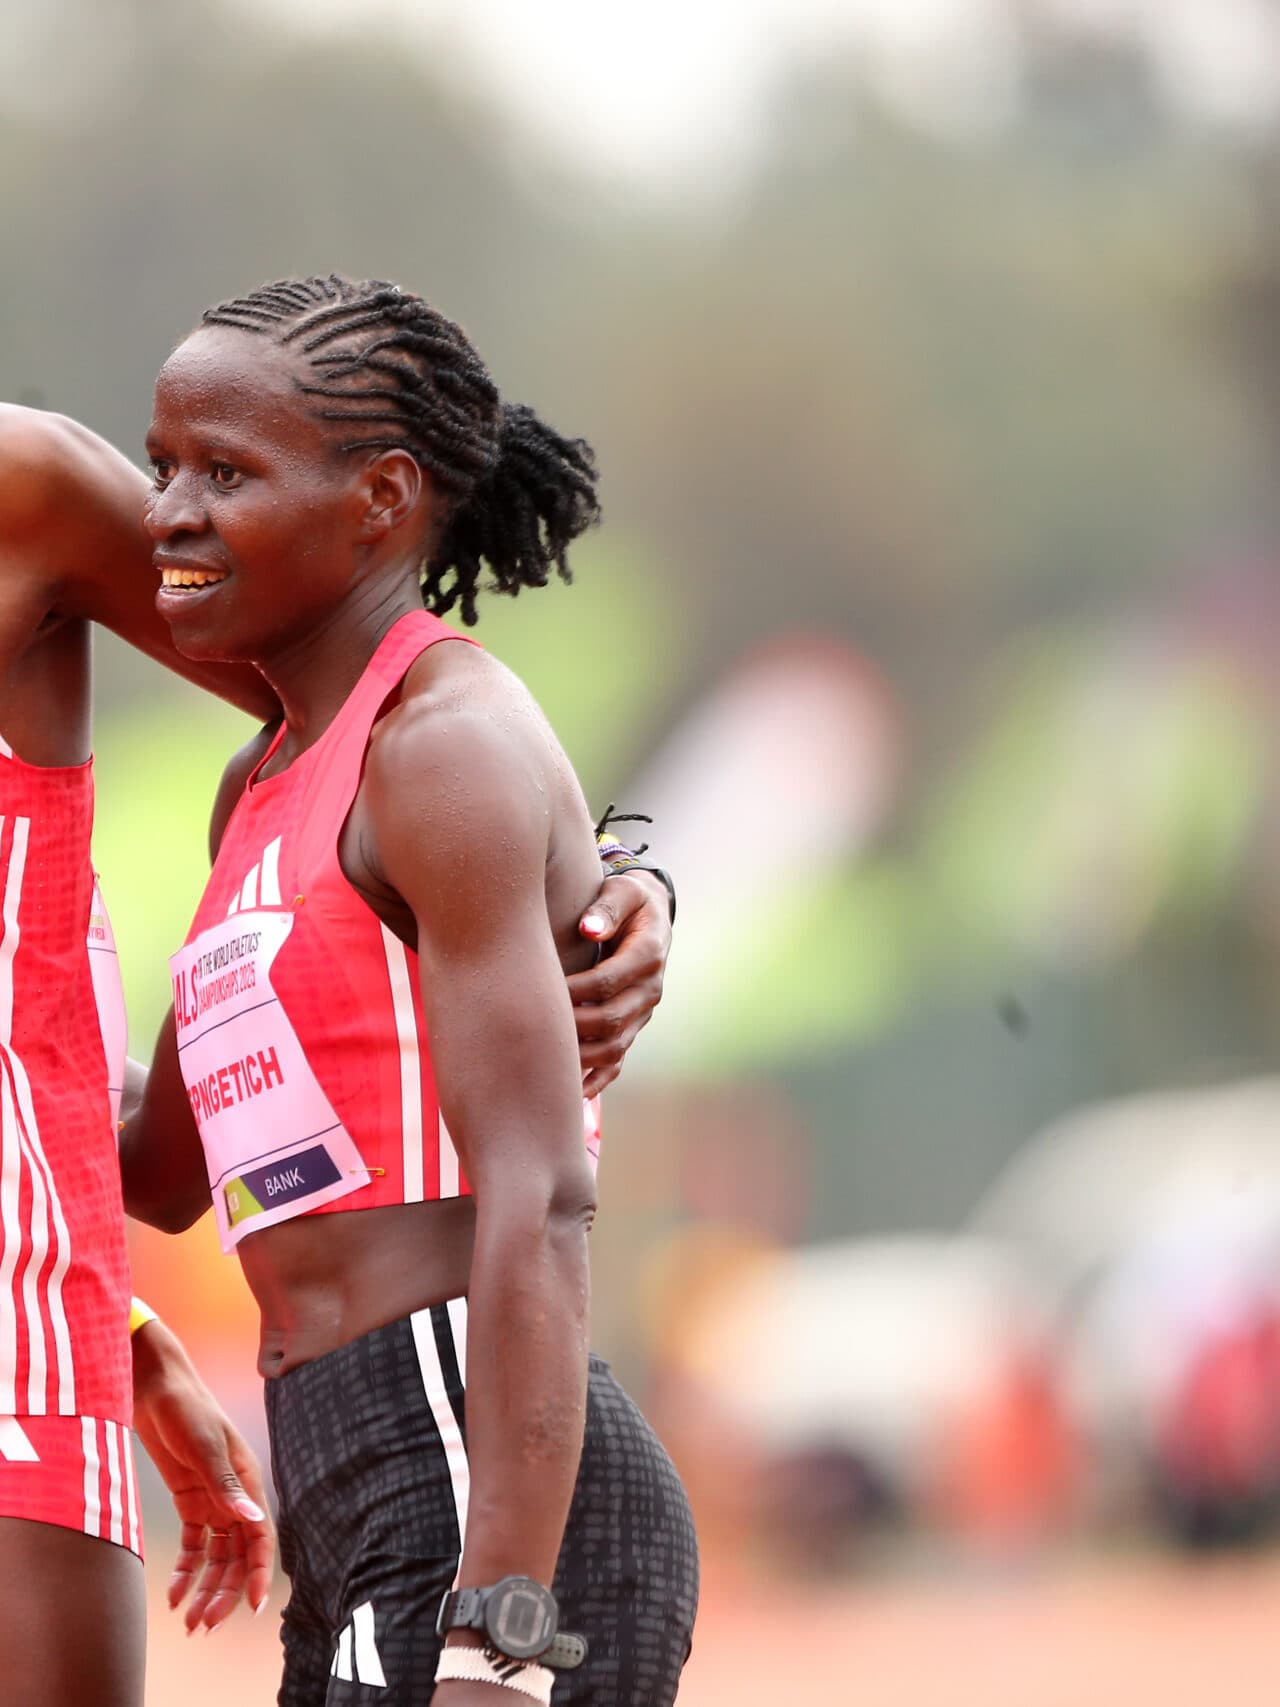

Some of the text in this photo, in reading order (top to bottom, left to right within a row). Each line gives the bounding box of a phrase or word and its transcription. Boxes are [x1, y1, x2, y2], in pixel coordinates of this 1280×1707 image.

[171, 963, 198, 1032] ALS
[199, 969, 239, 1016] HAMPIONSHIPS
[264, 1167, 305, 1197] BANK
